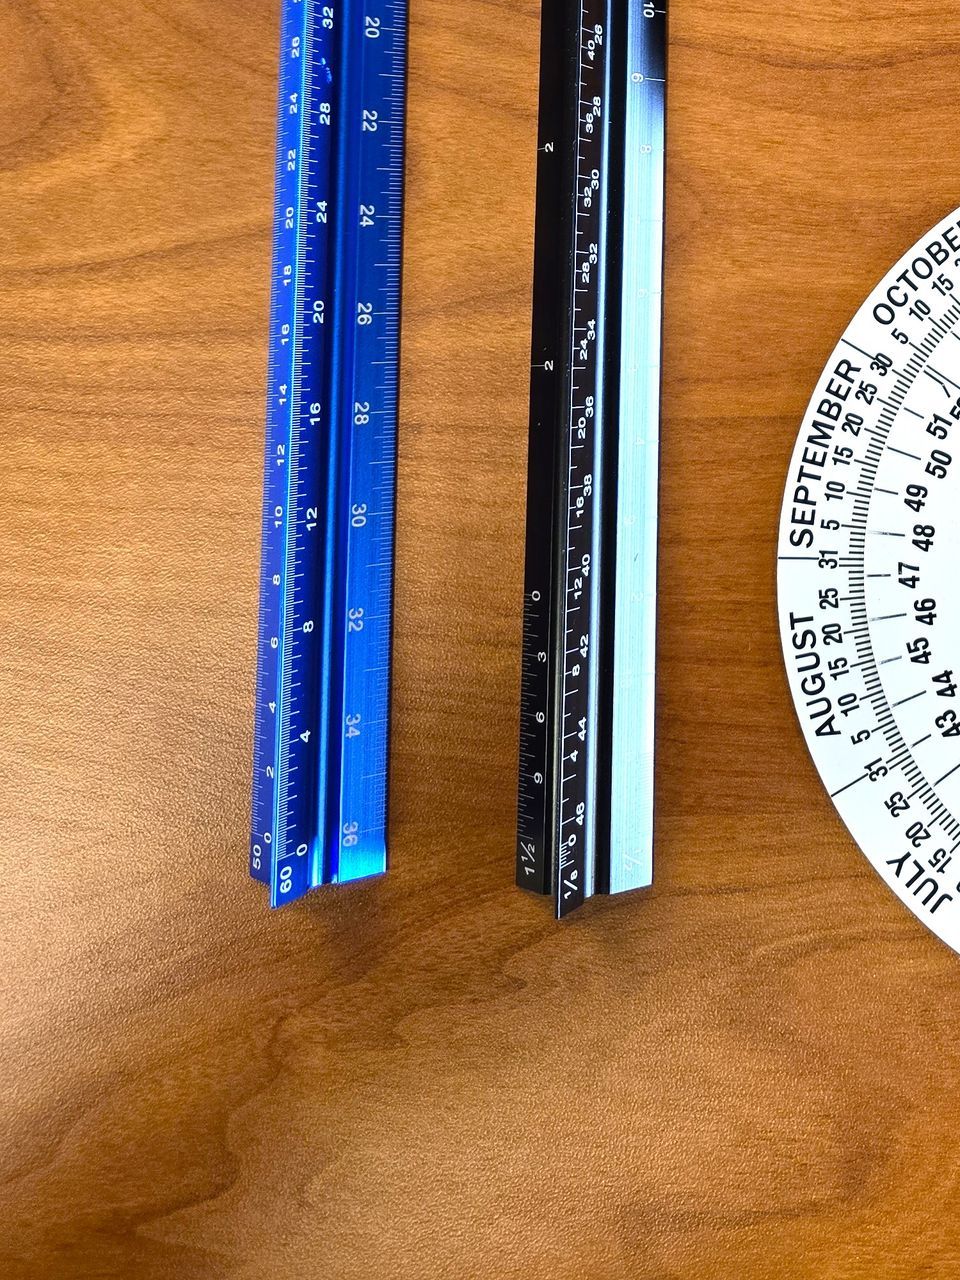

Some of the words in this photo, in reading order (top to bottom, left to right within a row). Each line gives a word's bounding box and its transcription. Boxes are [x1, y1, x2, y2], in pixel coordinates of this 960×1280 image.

[322, 7, 333, 29] 32
[366, 16, 380, 38] 20
[320, 103, 330, 125] 28
[363, 110, 377, 131] 22
[317, 201, 327, 223] 24
[360, 205, 374, 226] 24
[313, 301, 324, 323] 20
[358, 303, 372, 324] 26
[587, 319, 595, 340] 34
[310, 403, 320, 425] 16
[355, 402, 369, 424] 28
[586, 396, 593, 417] 36
[789, 358, 861, 549] SEPTEMBER
[925, 450, 952, 479] 50
[904, 485, 927, 512] 49
[306, 507, 317, 531] 12
[352, 504, 366, 527] 30
[582, 554, 590, 576] 40
[580, 634, 588, 657] 42
[789, 612, 841, 737] AUGUST
[536, 712, 544, 723] 6
[578, 717, 586, 741] 44
[280, 866, 292, 893] 60
[886, 851, 953, 914] JULY
